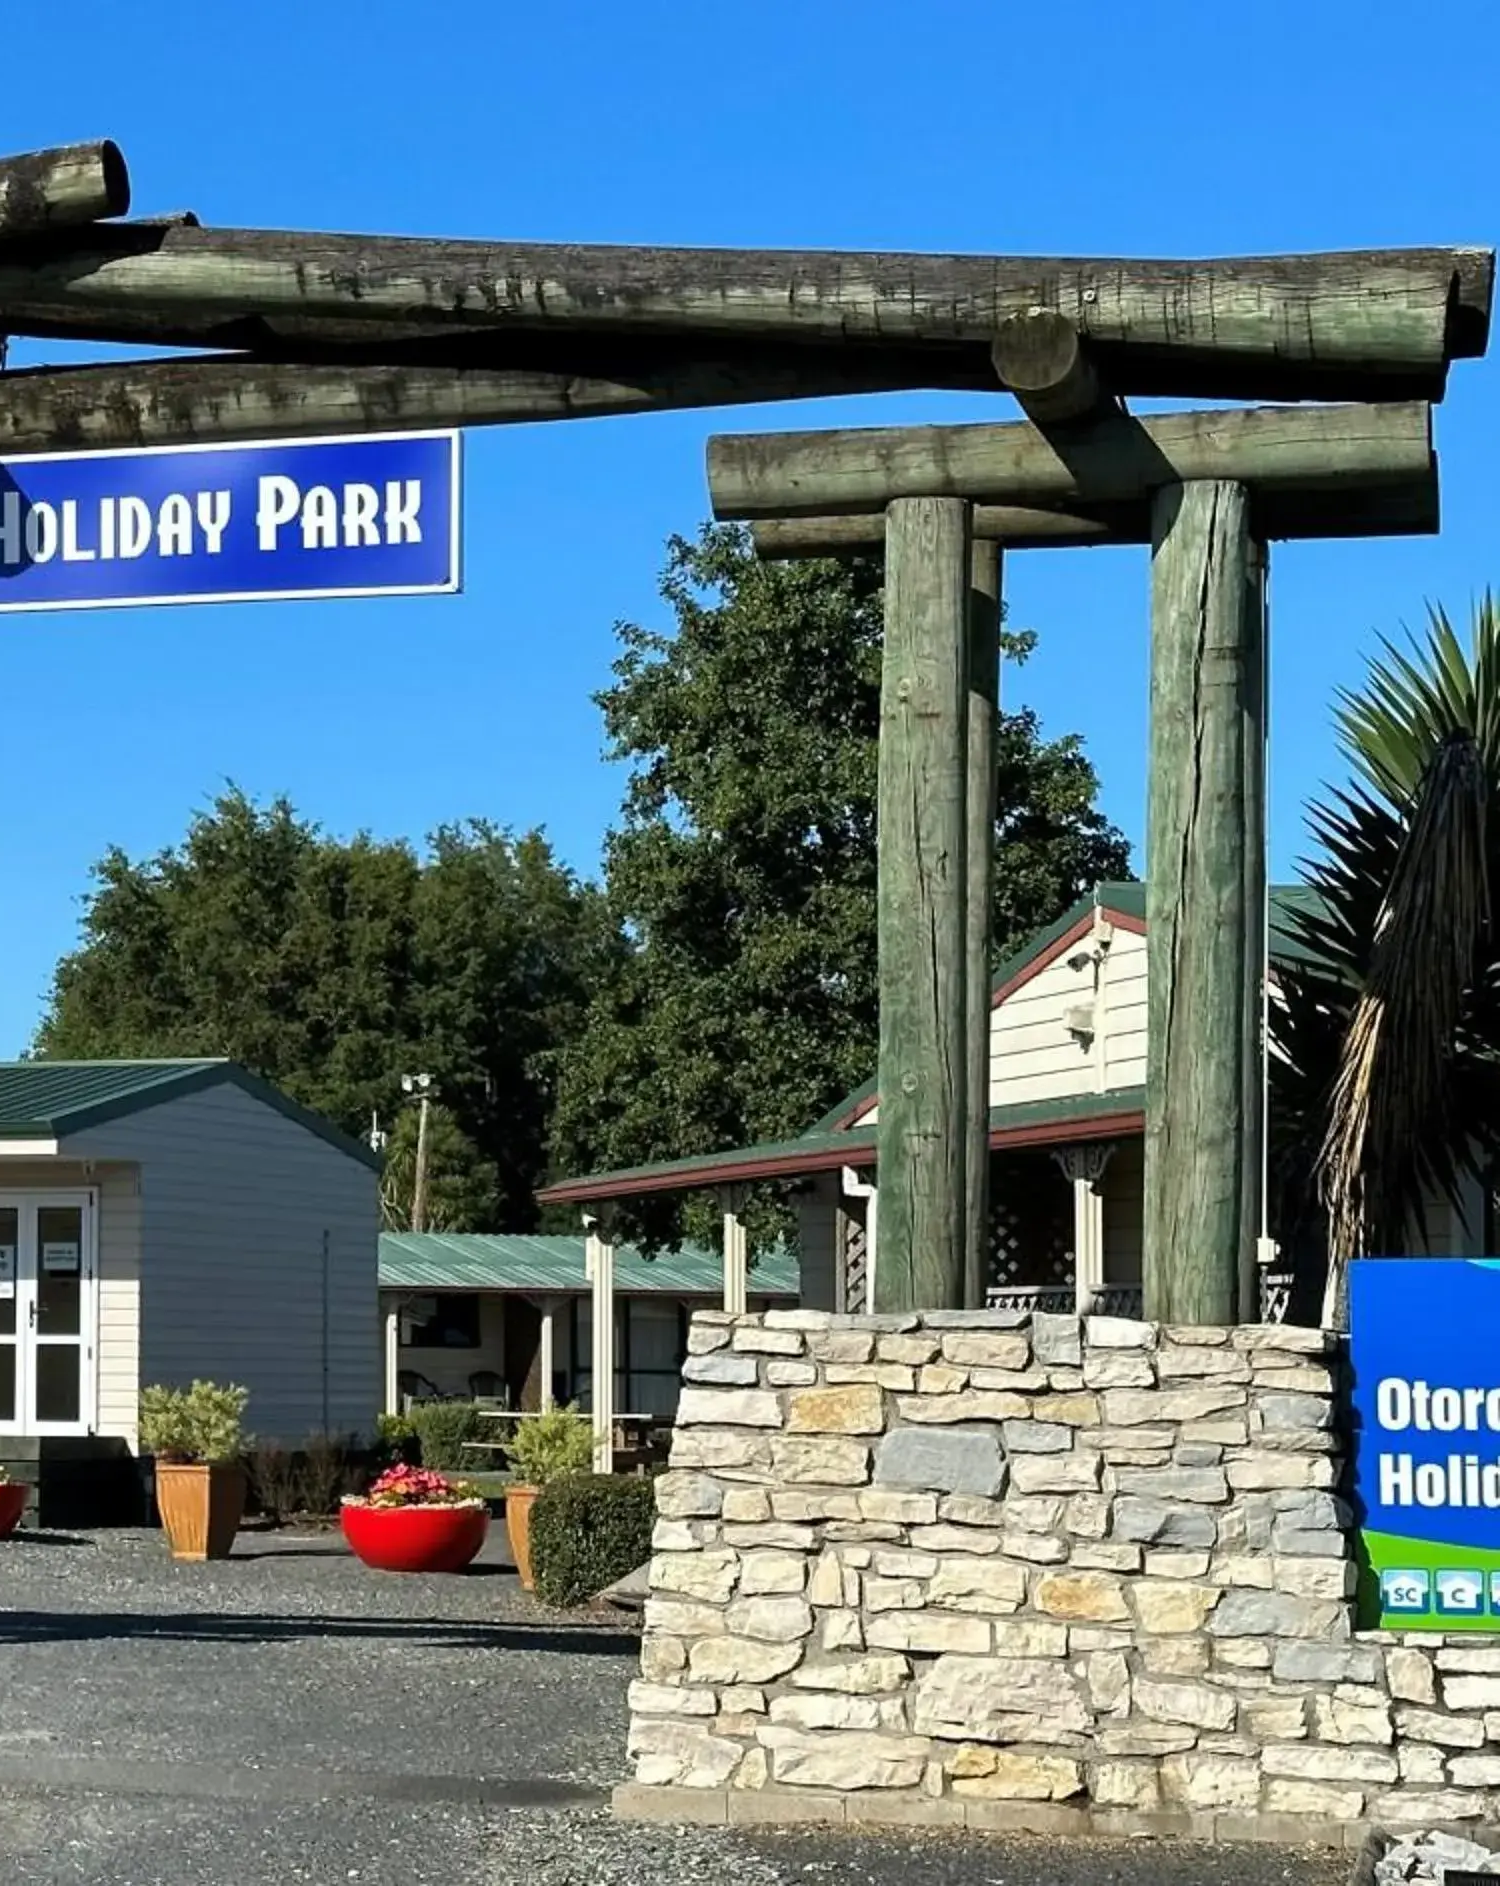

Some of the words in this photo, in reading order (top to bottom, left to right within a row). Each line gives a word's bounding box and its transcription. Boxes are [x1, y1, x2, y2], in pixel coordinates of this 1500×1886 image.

[256, 475, 423, 551] PARK
[1393, 1587, 1418, 1603] SC
[1451, 1588, 1466, 1604] C
